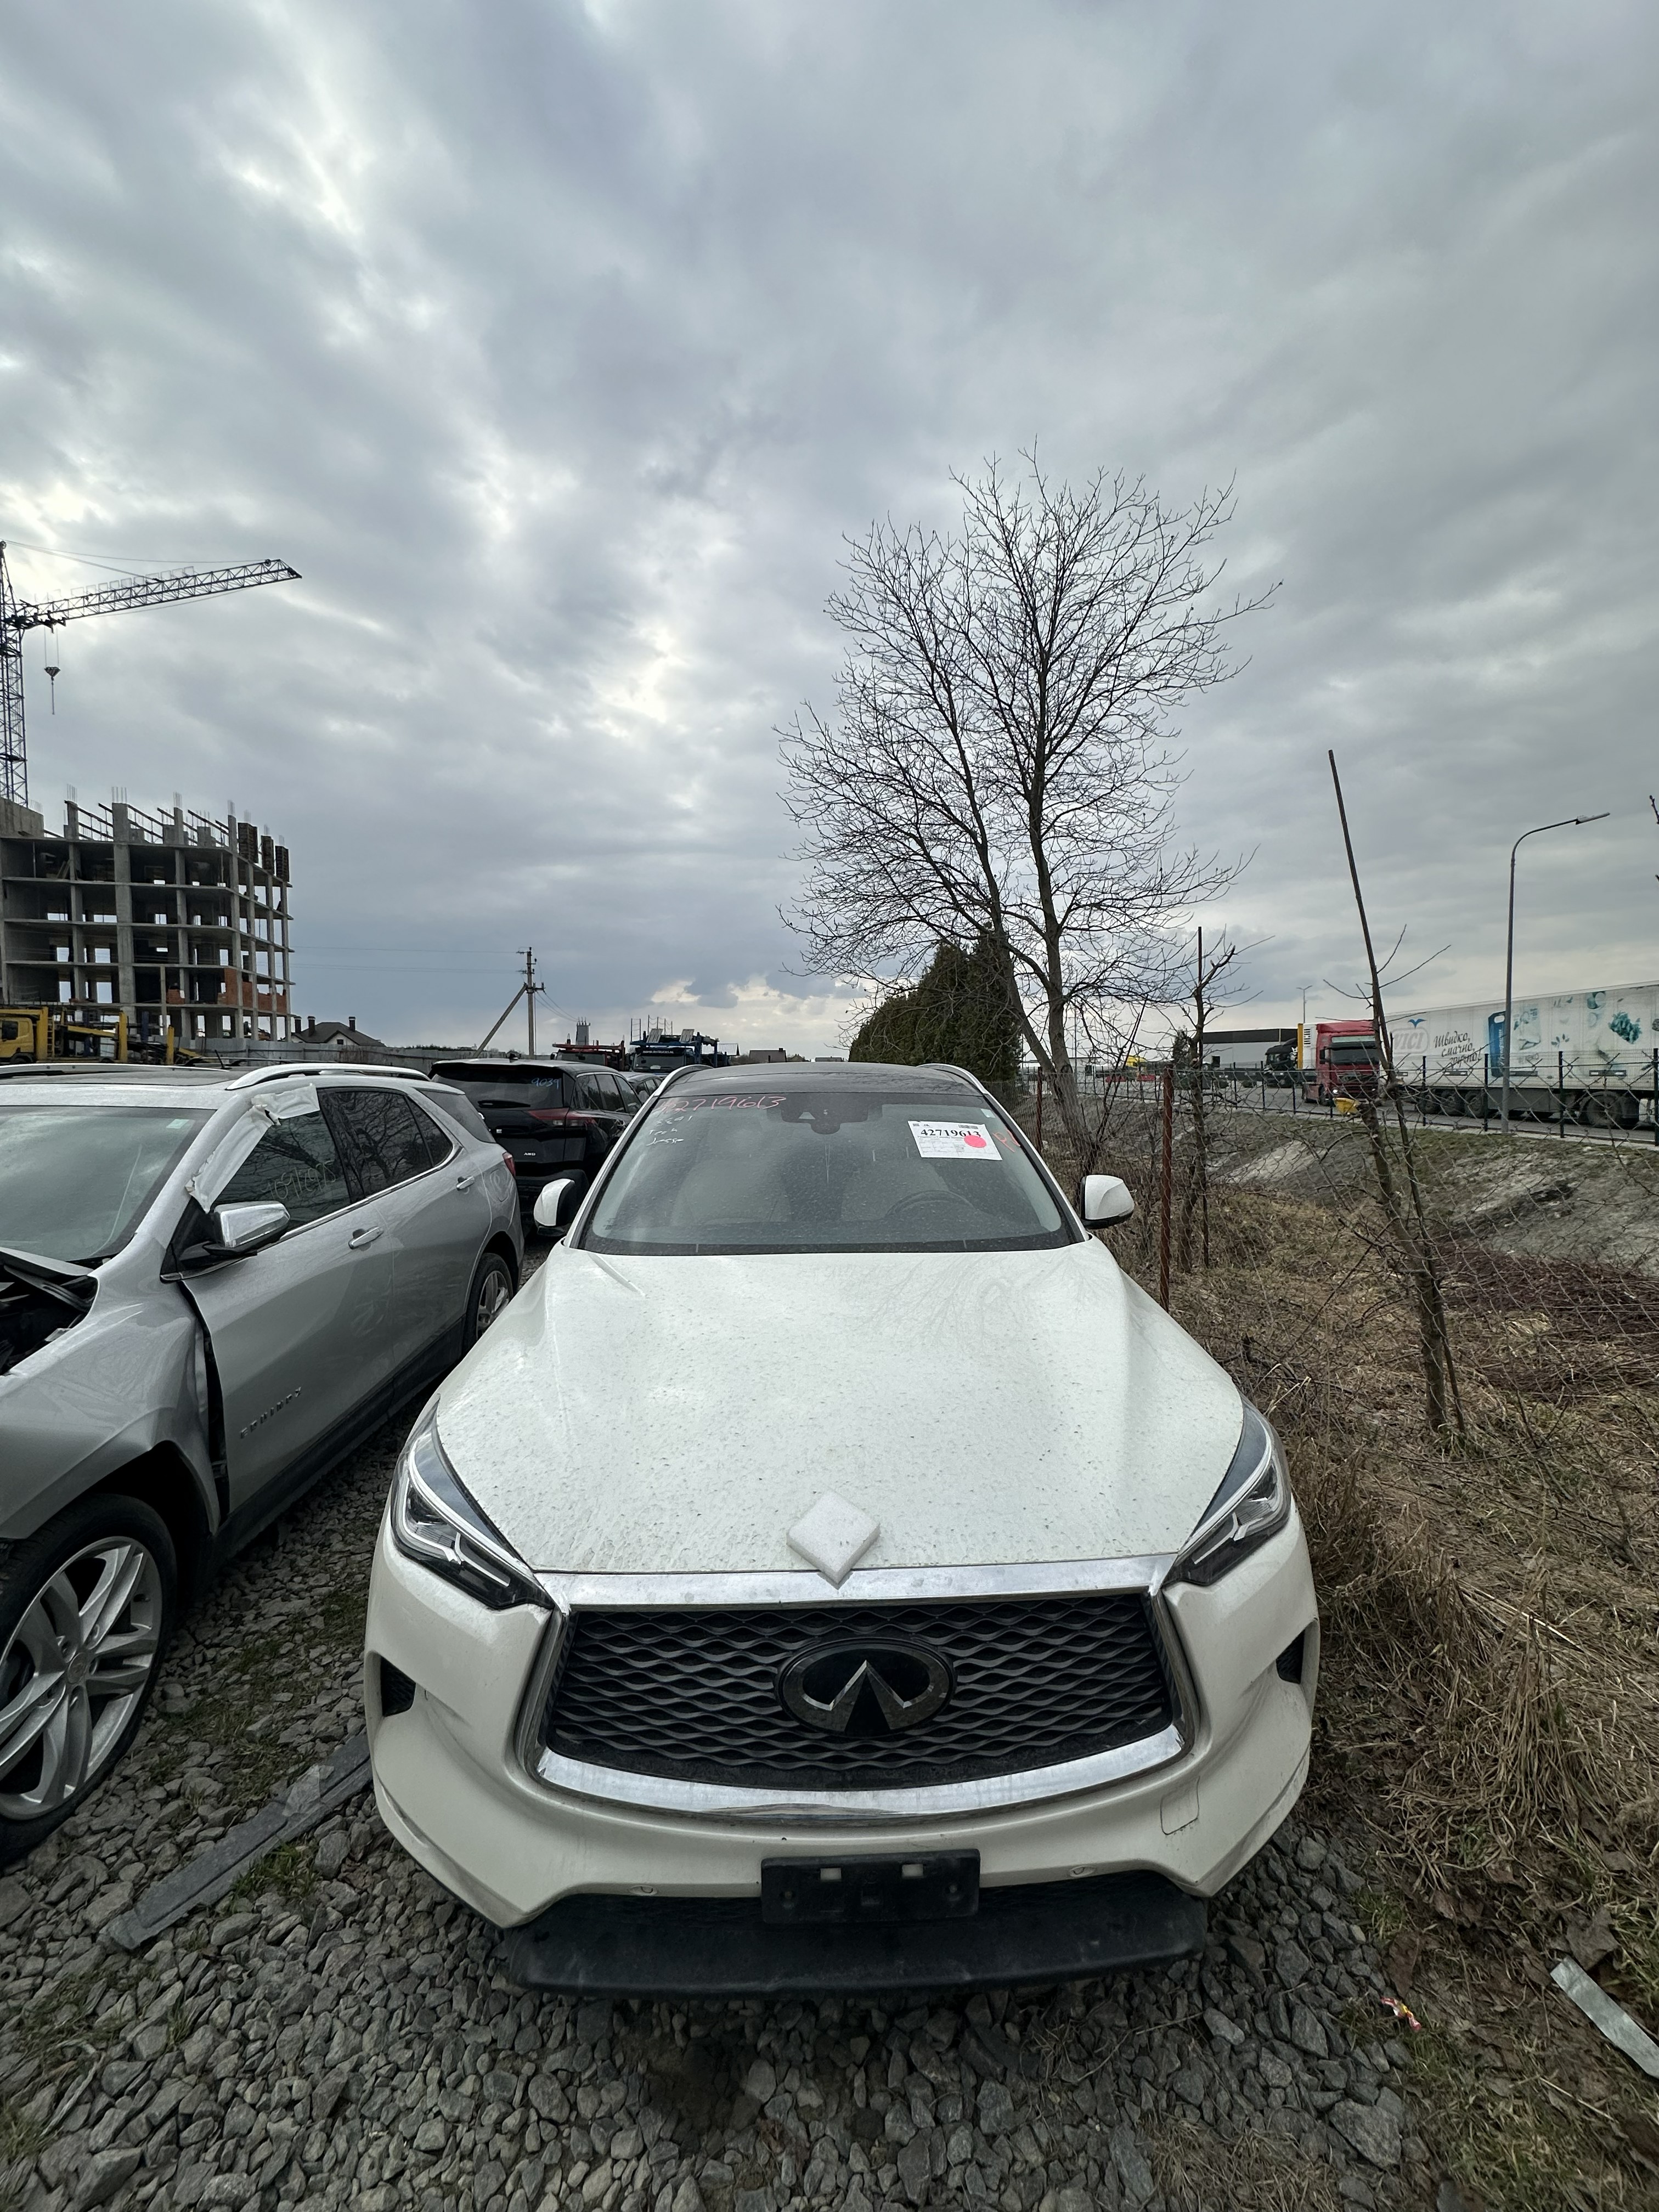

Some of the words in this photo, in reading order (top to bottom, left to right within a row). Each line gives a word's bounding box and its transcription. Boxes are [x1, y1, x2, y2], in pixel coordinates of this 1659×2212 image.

[1433, 1030, 1470, 1048] Швидко,
[1441, 1042, 1475, 1057] смачно,
[531, 1077, 559, 1090] 9039
[921, 1128, 981, 1138] 42719613
